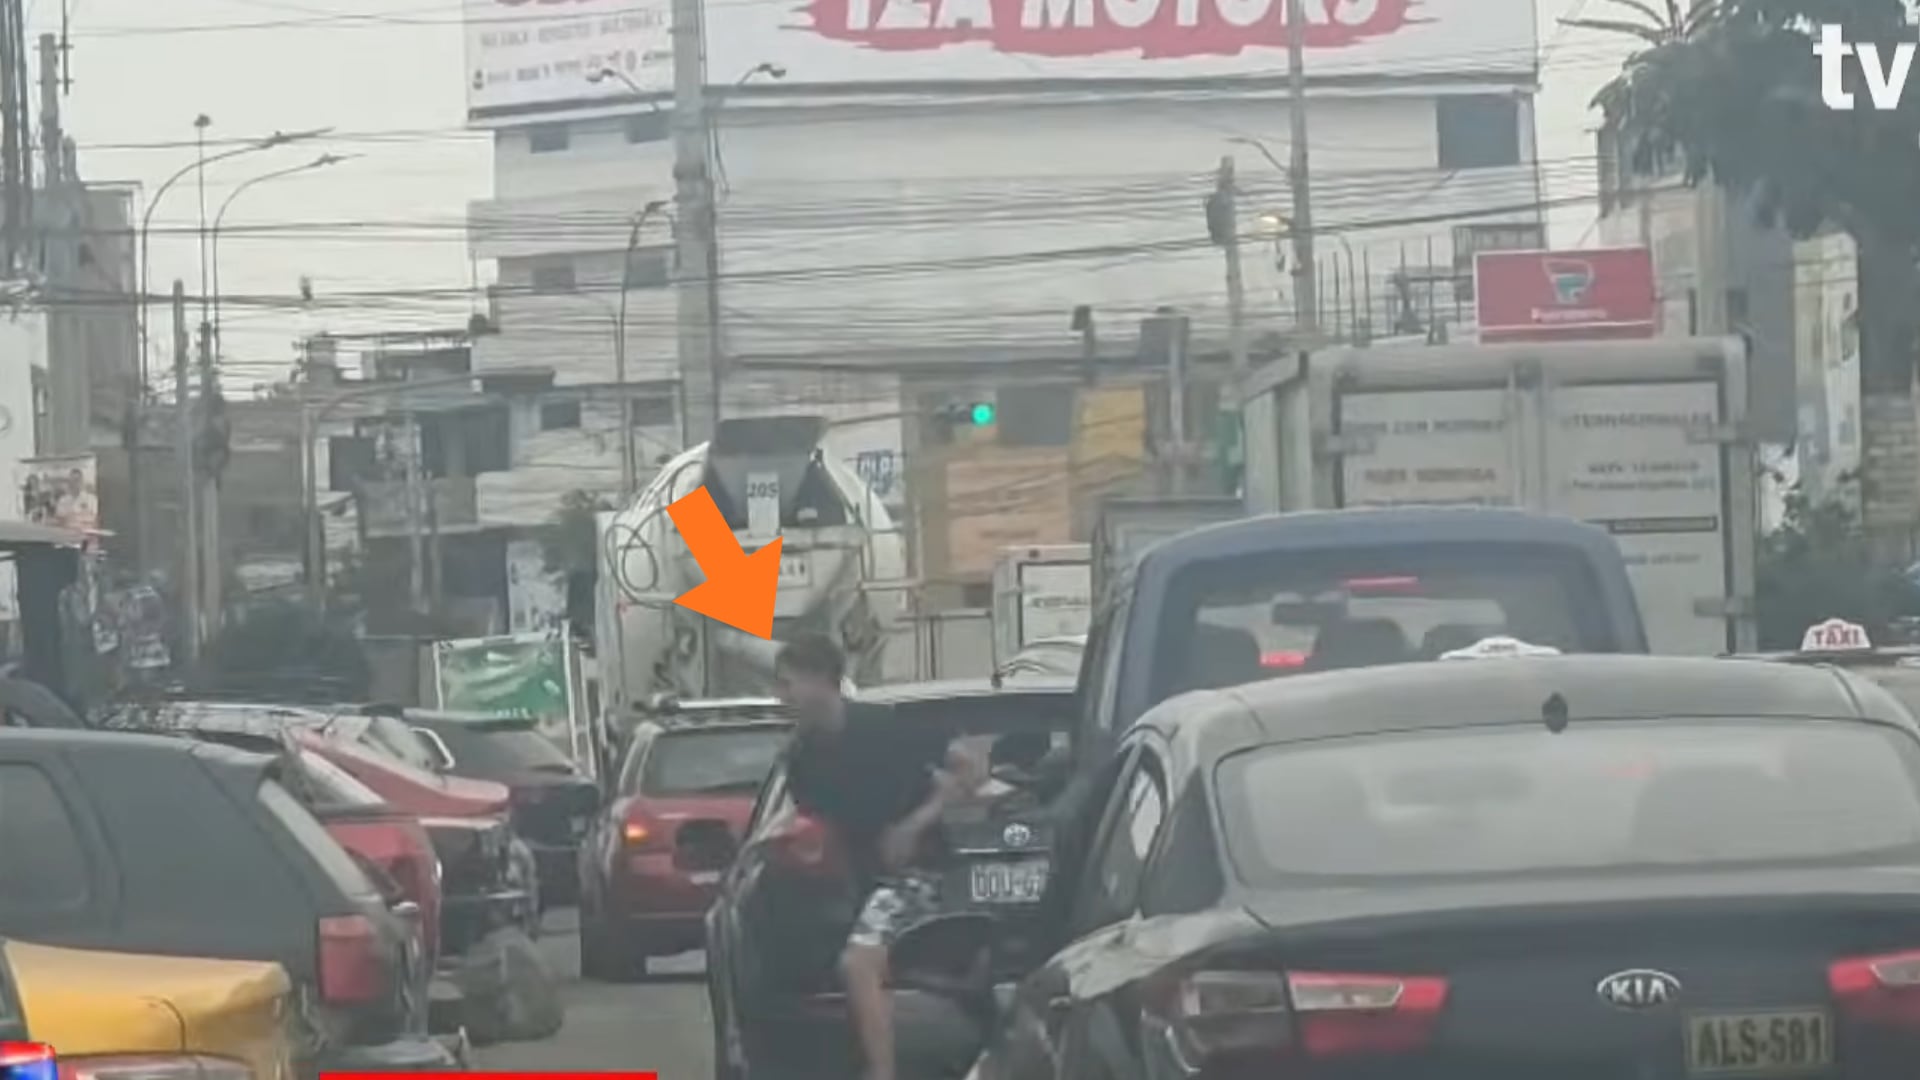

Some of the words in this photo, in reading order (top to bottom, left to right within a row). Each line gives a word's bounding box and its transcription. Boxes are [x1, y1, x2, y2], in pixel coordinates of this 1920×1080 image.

[1814, 629, 1859, 646] TAXI
[1611, 978, 1668, 1003] KIA
[1699, 1016, 1822, 1066] ALS-581
